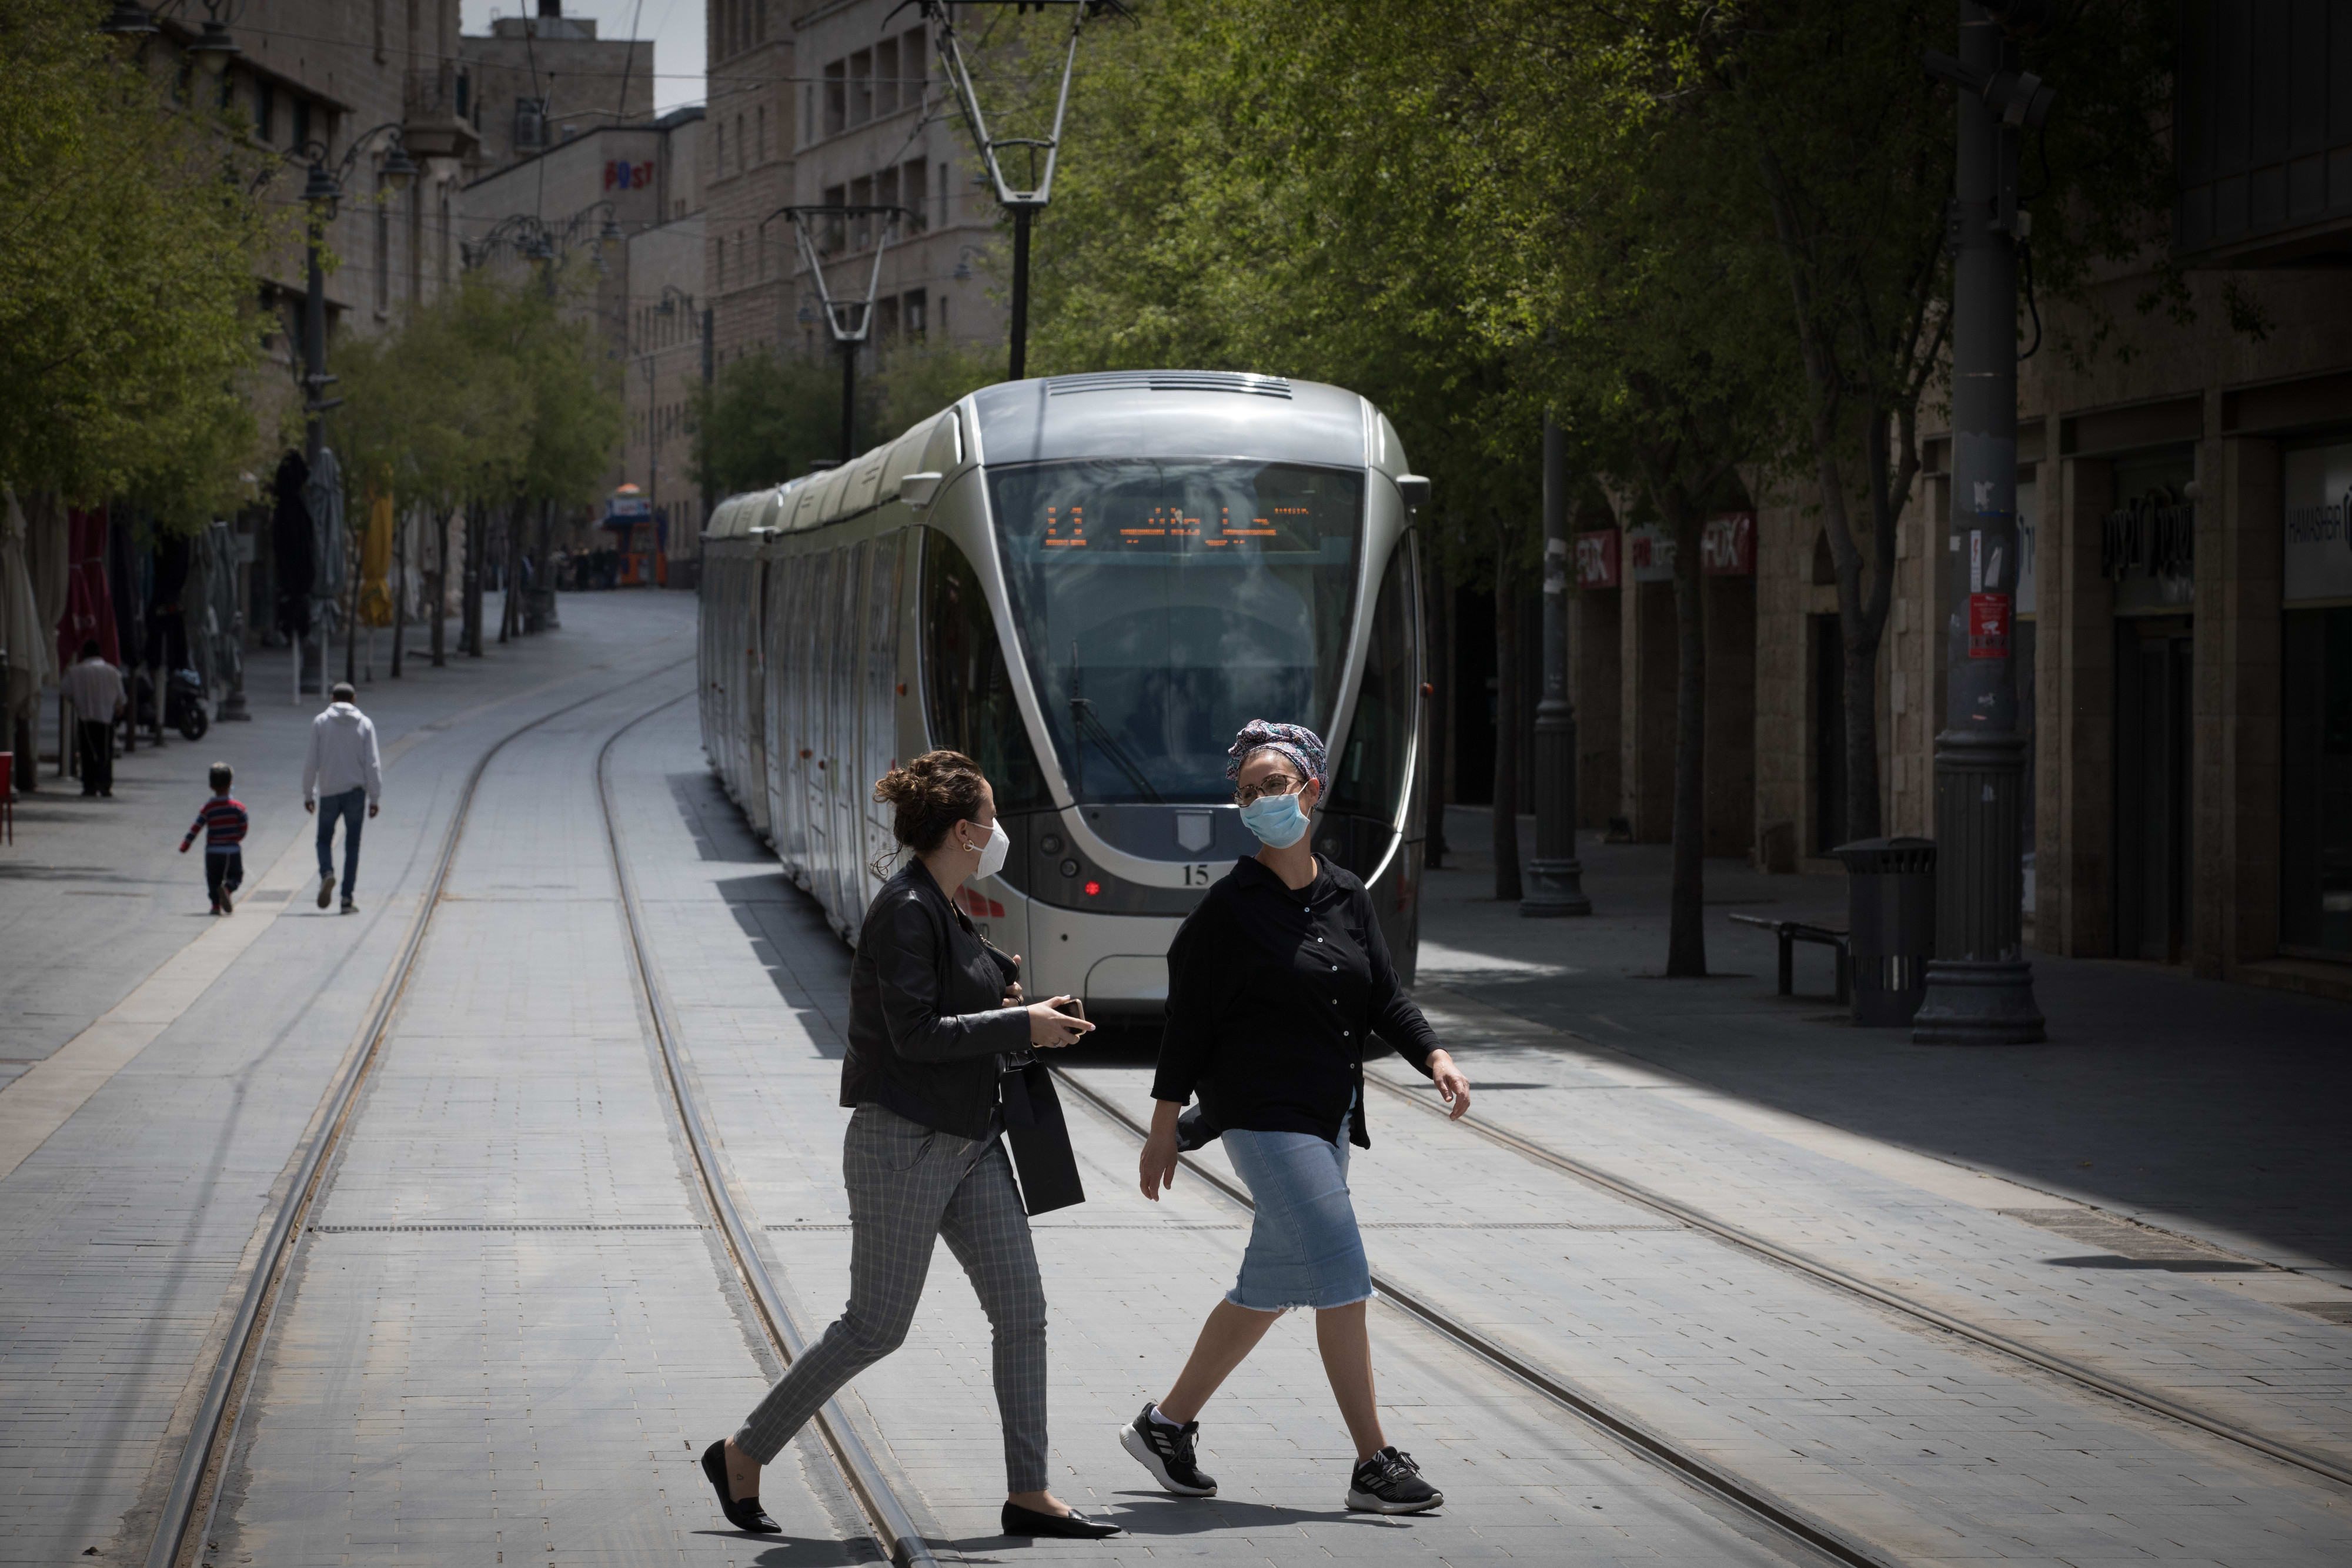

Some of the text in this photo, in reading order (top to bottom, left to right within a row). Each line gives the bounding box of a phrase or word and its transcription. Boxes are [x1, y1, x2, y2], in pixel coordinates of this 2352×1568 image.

[605, 161, 654, 191] POST
[1576, 536, 1609, 583] FOX
[1701, 514, 1741, 568] FOX
[1183, 865, 1209, 885] 15
